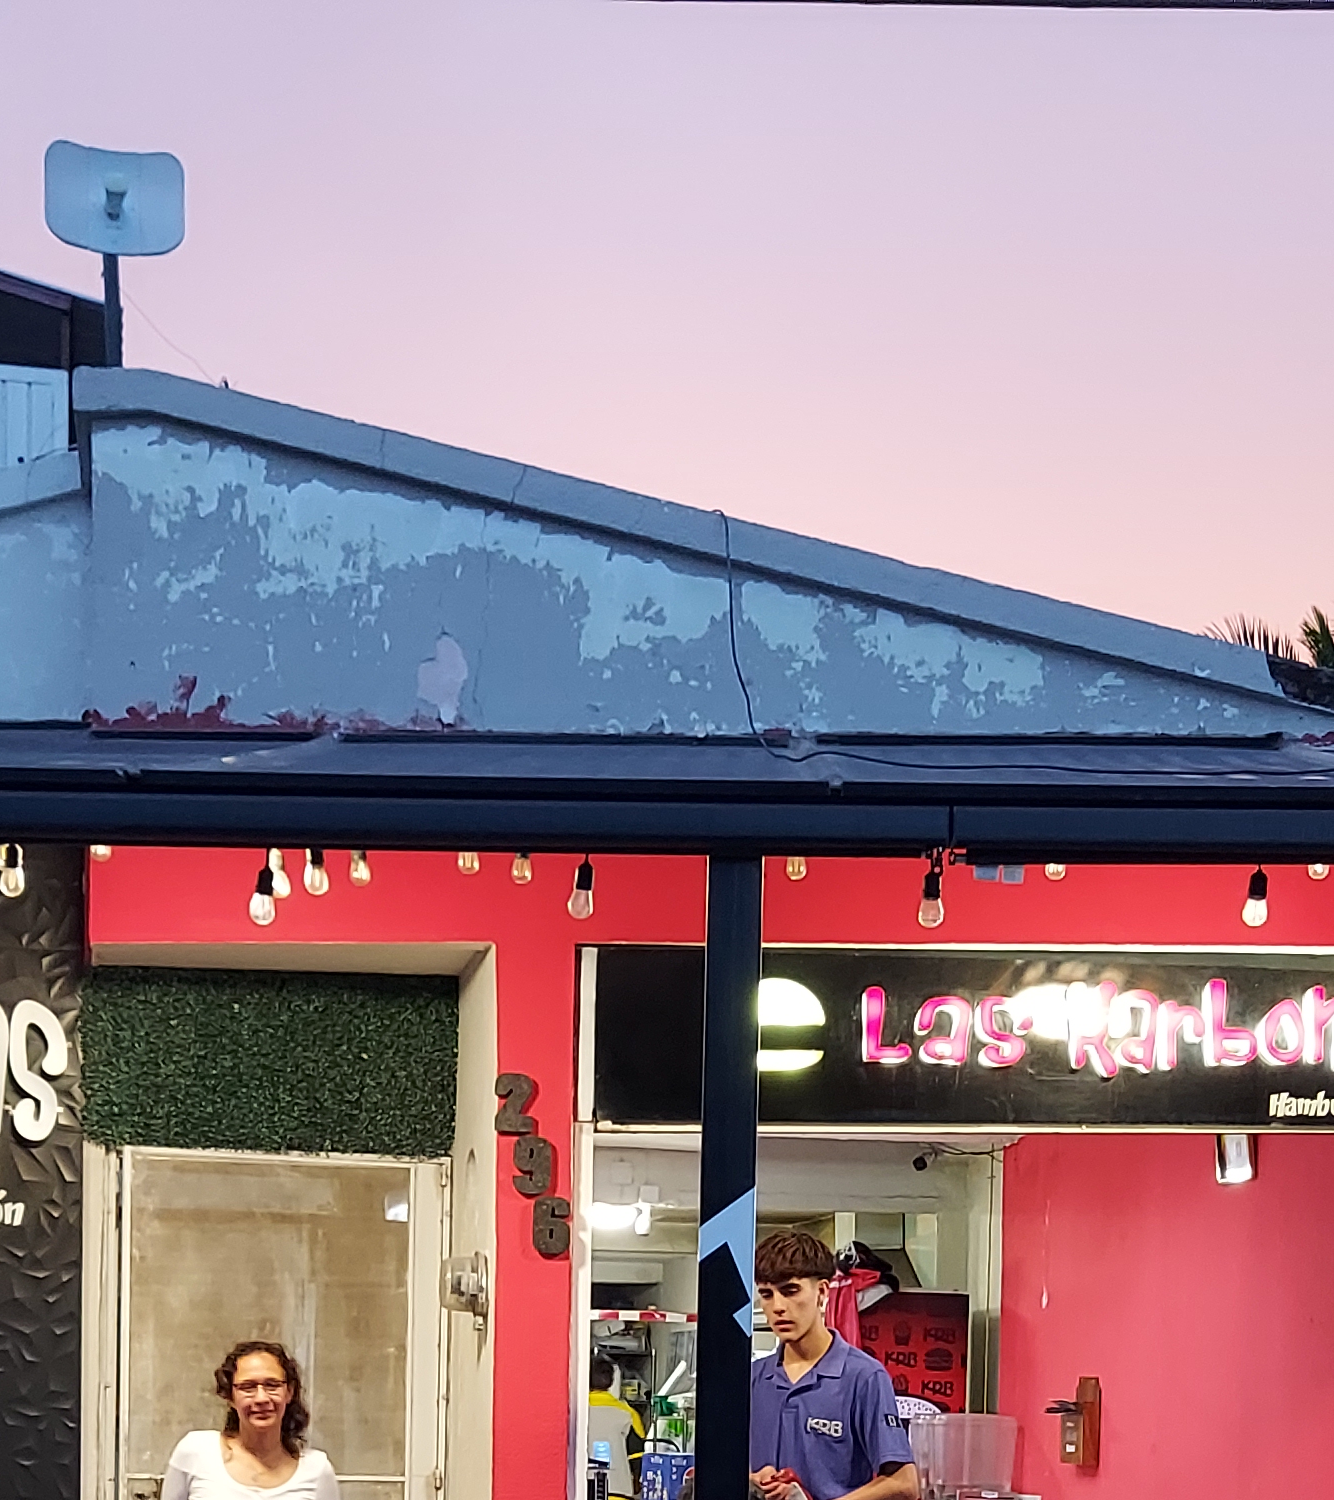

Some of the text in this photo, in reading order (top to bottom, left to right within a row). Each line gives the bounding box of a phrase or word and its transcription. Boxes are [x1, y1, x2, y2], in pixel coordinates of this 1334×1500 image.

[862, 985, 1033, 1068] Las
[884, 1351, 918, 1368] KRB
[920, 1380, 955, 1398] KRB
[806, 1416, 843, 1438] KRB
